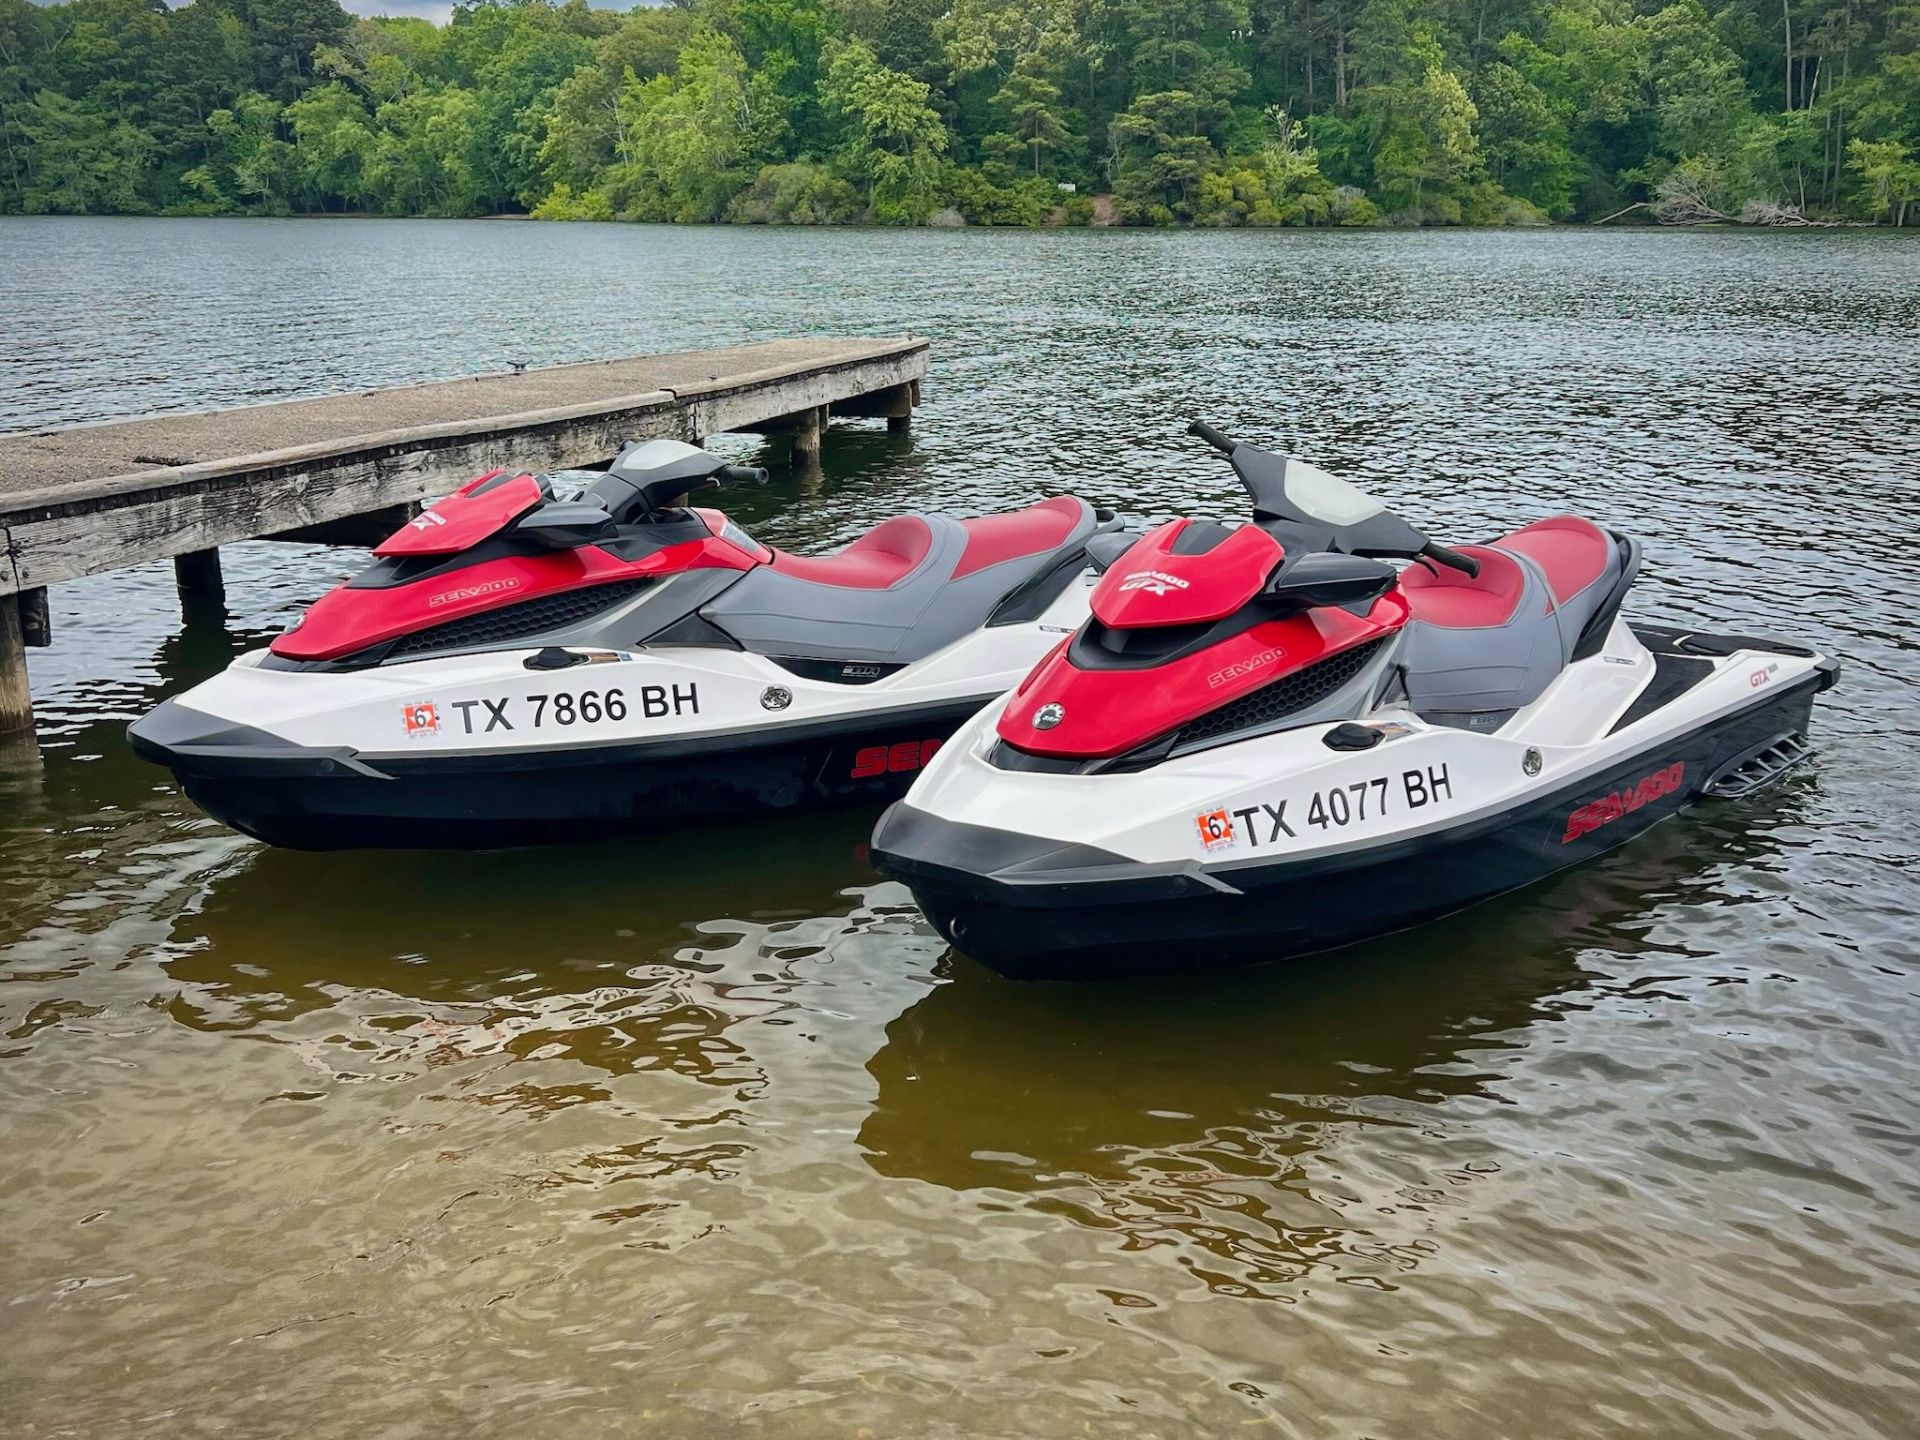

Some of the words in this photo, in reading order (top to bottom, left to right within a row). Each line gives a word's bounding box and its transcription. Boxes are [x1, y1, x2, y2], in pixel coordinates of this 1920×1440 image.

[414, 707, 427, 728] 6
[452, 697, 515, 734] TX
[526, 688, 627, 728] 7866
[641, 682, 700, 718] BH
[1233, 799, 1297, 847] TX
[1307, 777, 1389, 830] 4077
[1402, 762, 1453, 809] BH
[1208, 815, 1221, 839] 6
